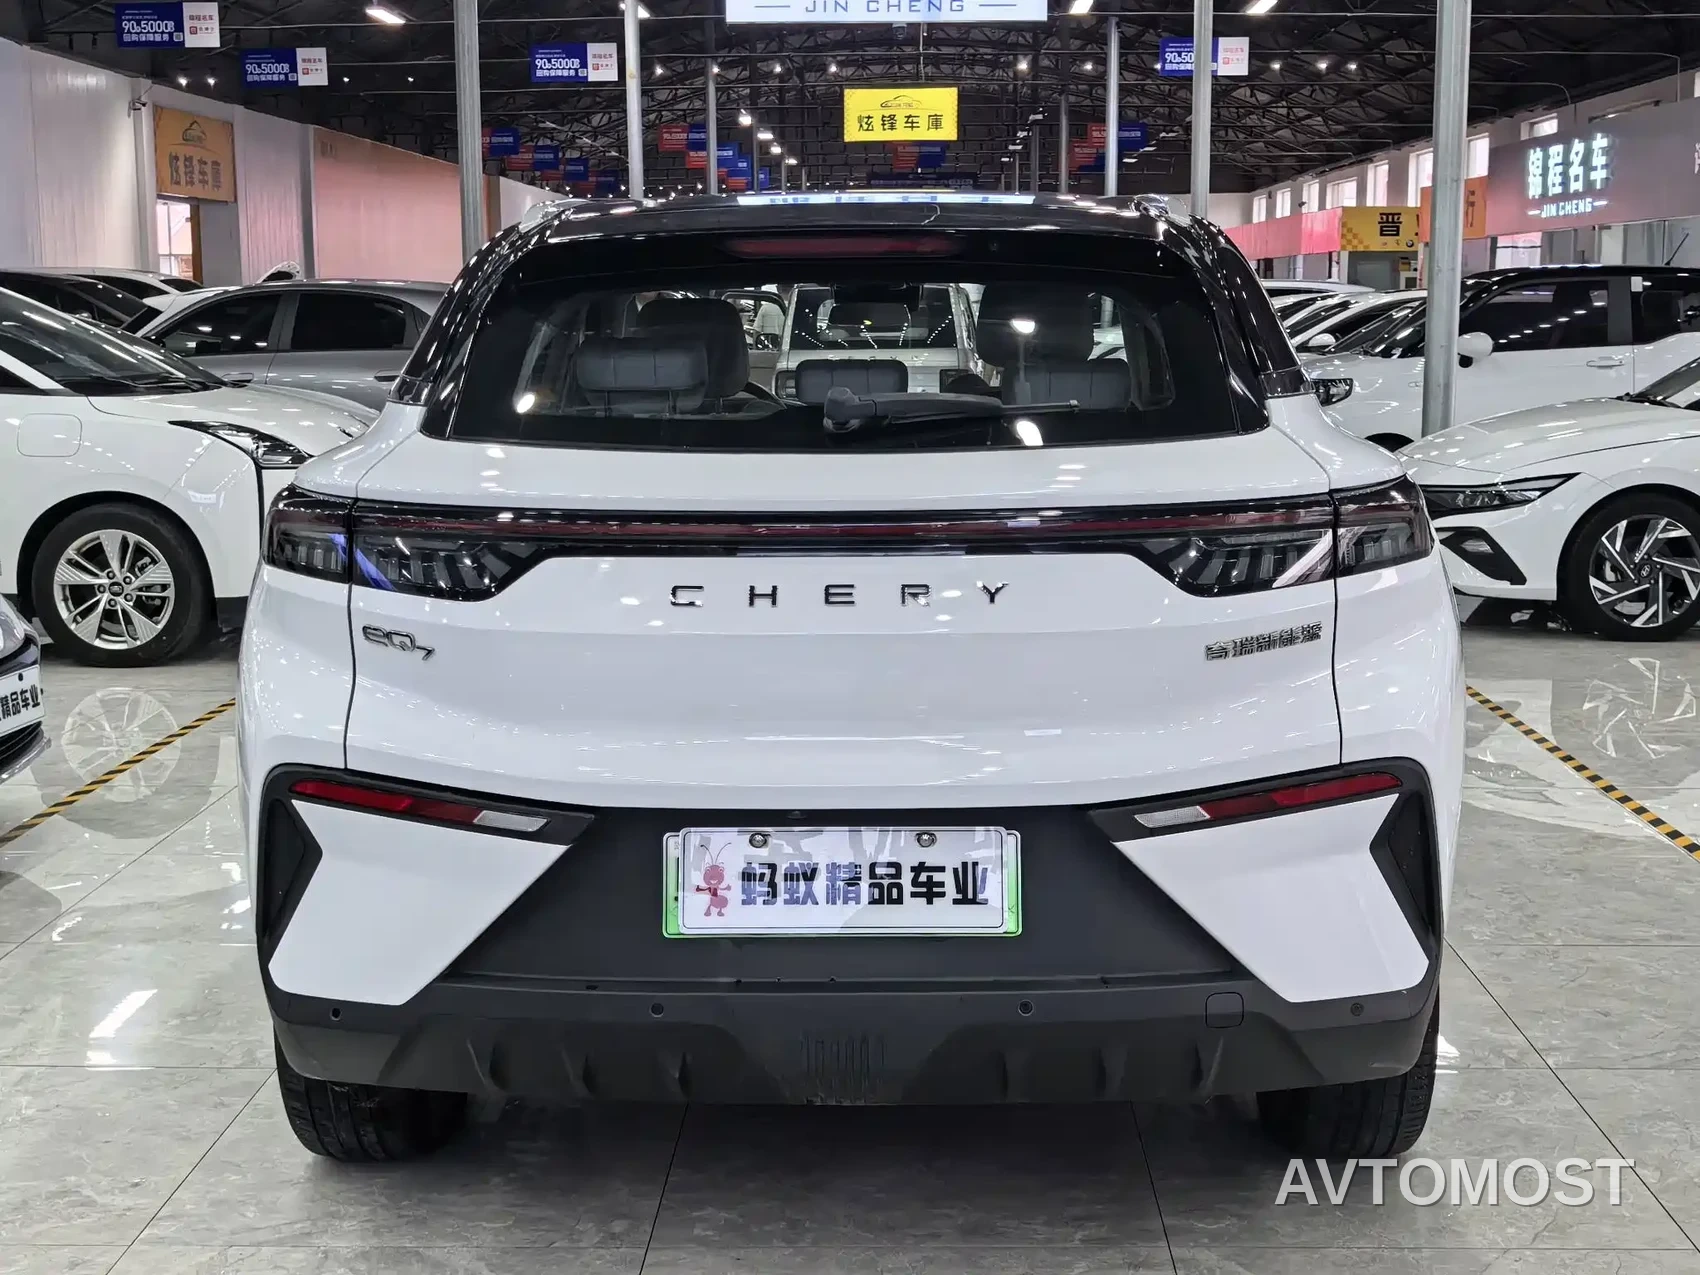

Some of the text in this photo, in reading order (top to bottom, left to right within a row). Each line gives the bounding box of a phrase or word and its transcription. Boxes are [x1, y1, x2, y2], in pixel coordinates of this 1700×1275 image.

[805, 0, 964, 13] JIN CHENG
[857, 114, 944, 132] 炫锋车庫
[1541, 197, 1593, 218] JIN CHENG
[669, 582, 1009, 607] CHERY
[741, 861, 989, 905] 蚂蚁精品车业
